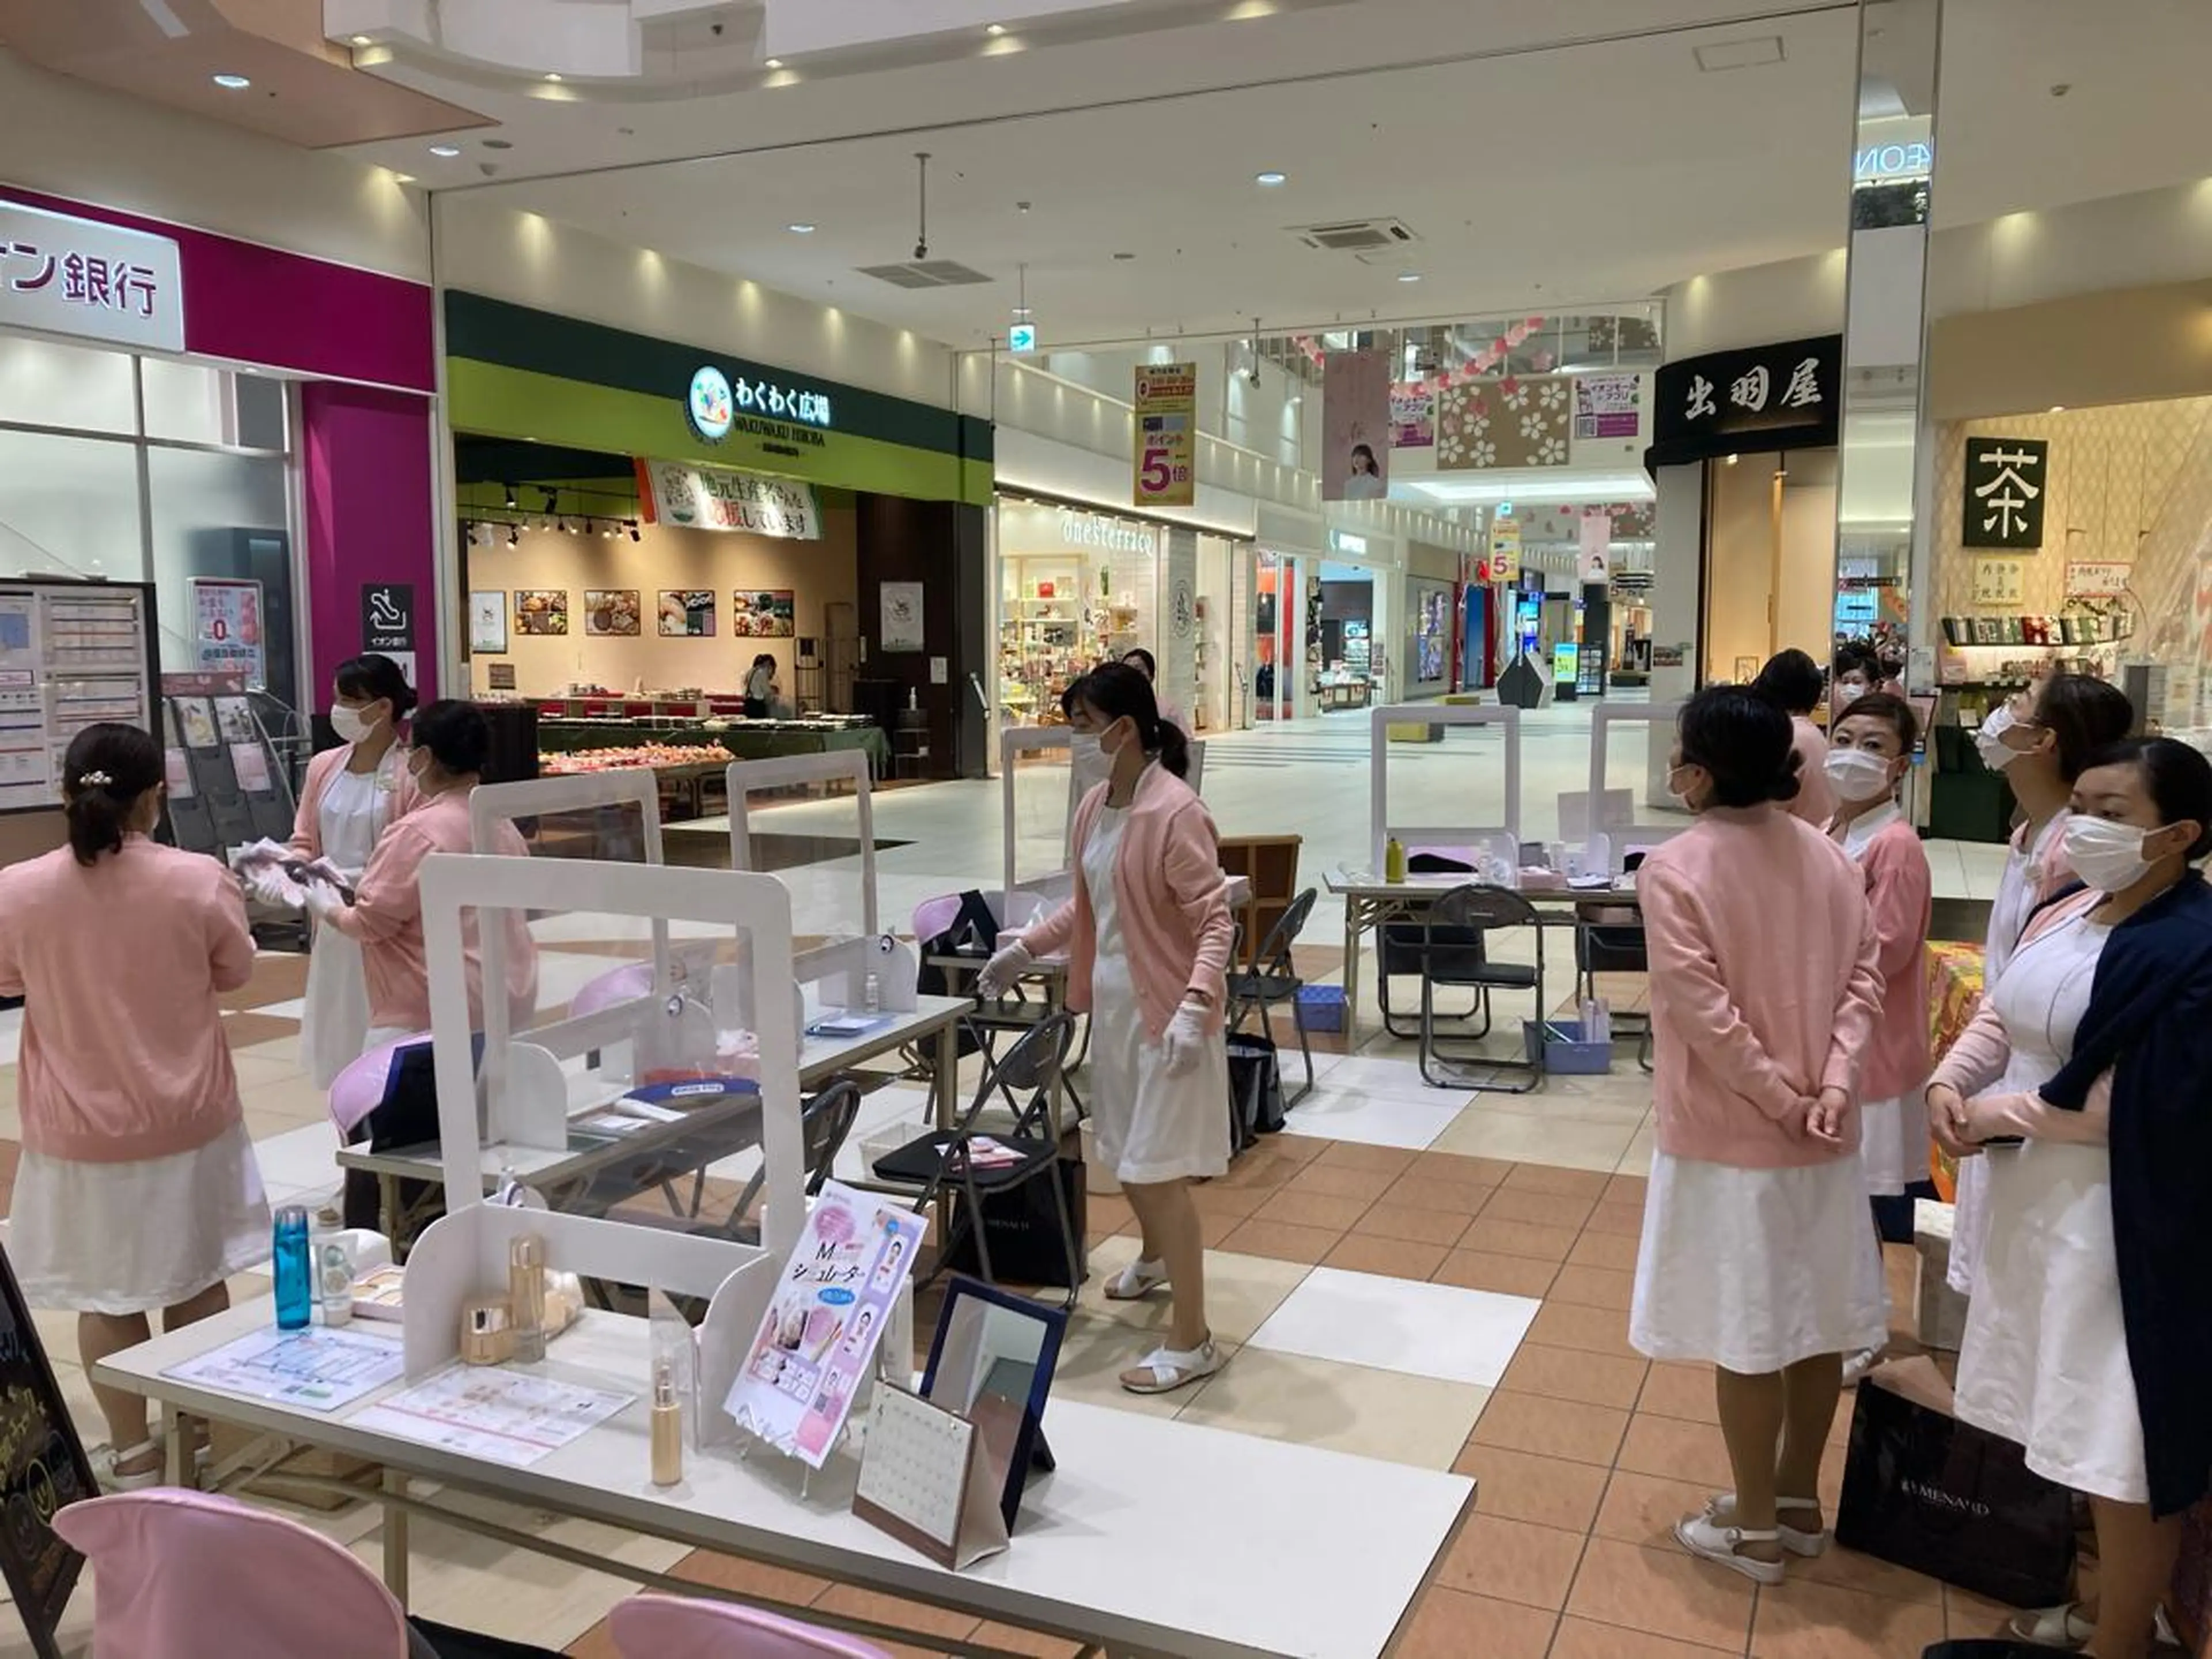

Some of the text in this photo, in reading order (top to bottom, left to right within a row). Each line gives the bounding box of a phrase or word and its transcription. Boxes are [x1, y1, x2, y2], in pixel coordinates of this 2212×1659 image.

[0, 243, 157, 316] ン銀行
[736, 377, 830, 427] わくわく広場
[1685, 358, 1823, 420] 出羽屋
[1975, 448, 2040, 539] 茶
[816, 1241, 836, 1260] M
